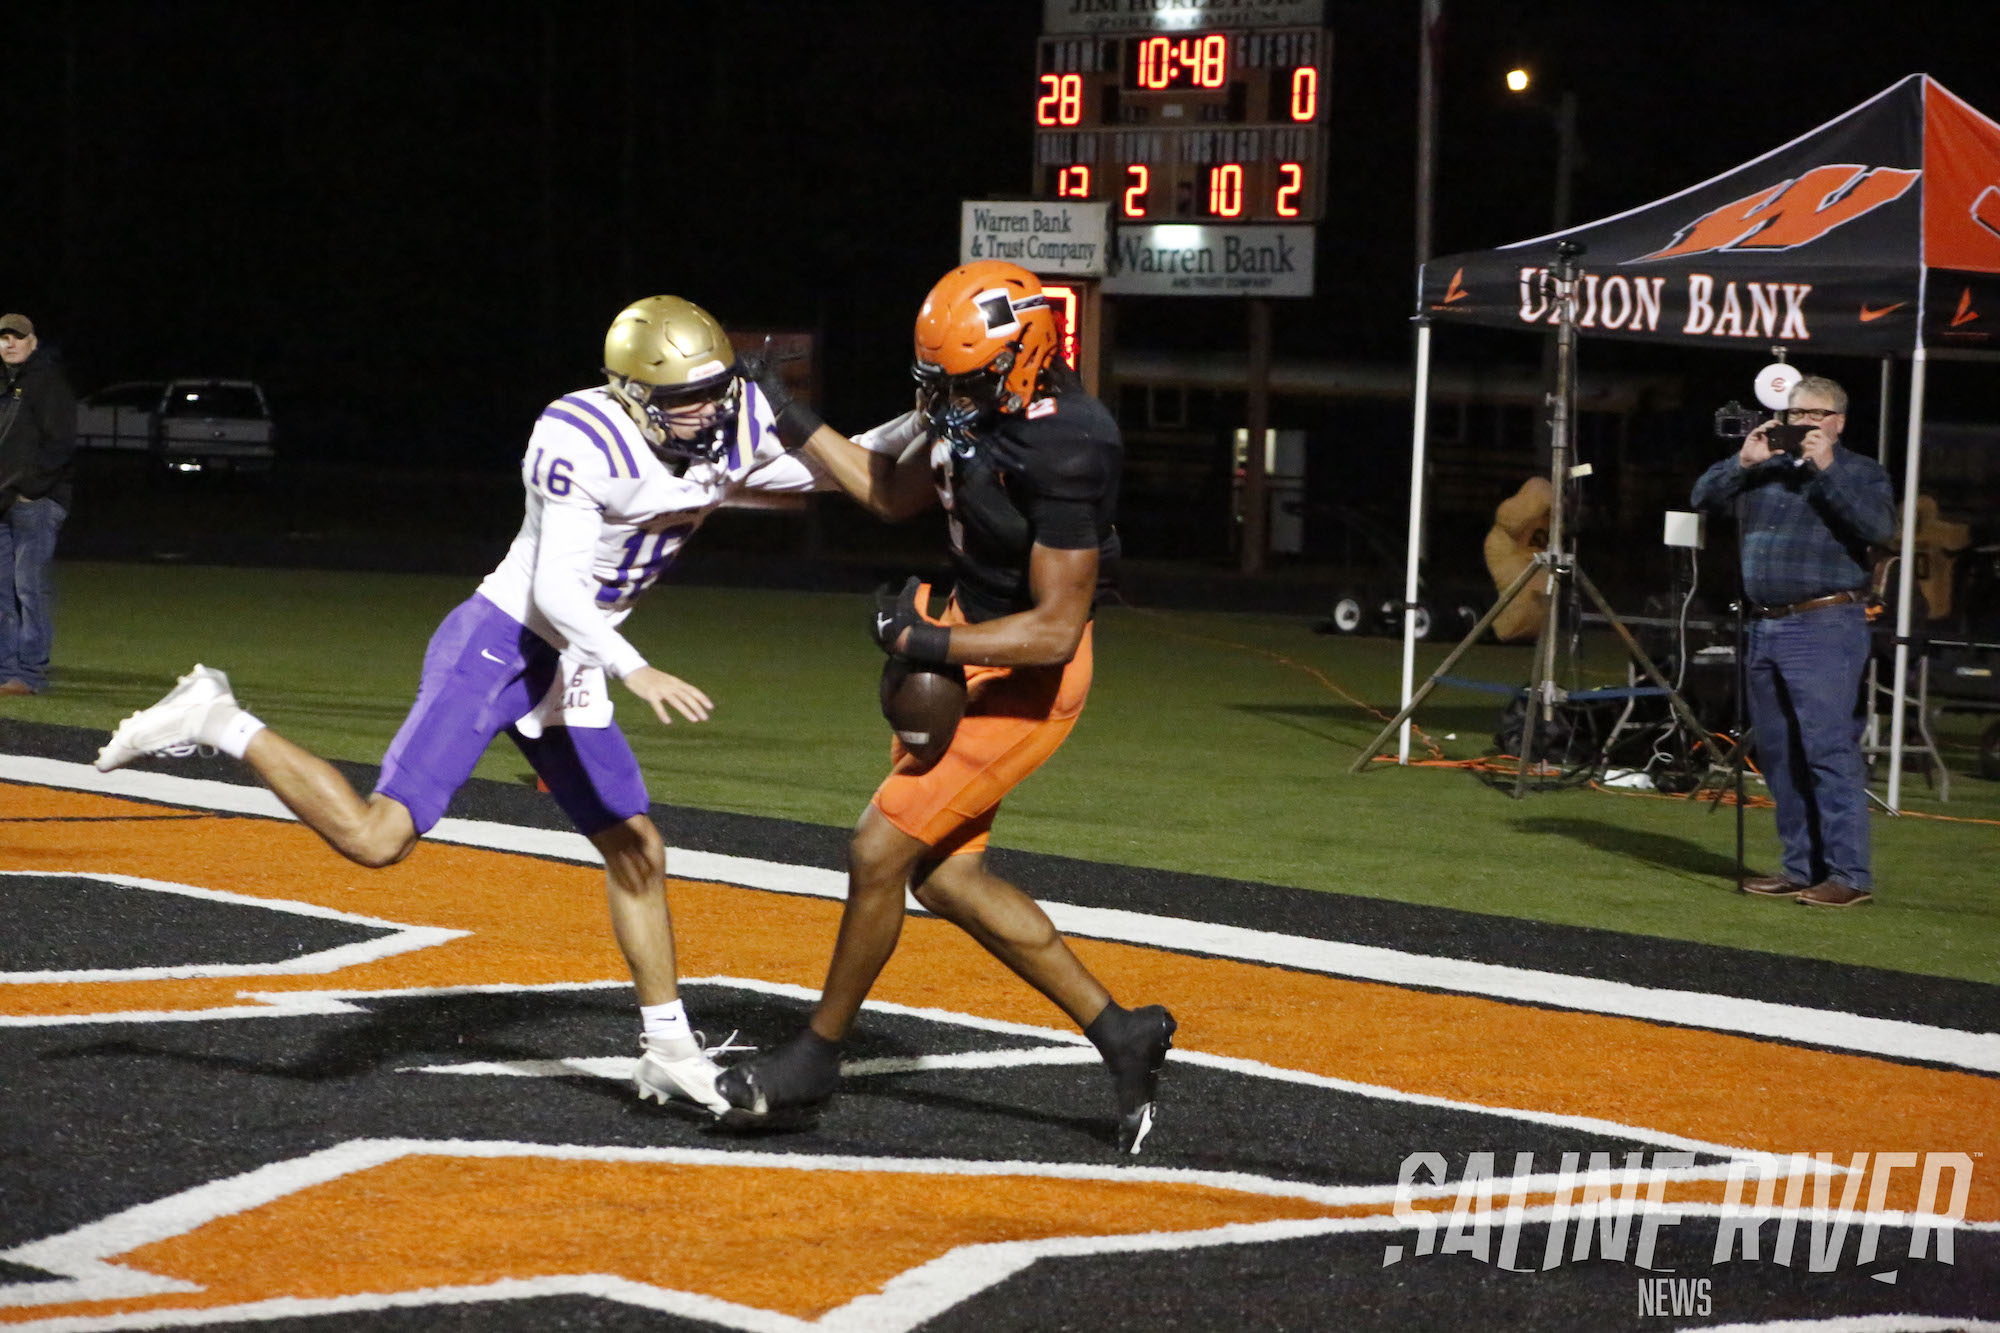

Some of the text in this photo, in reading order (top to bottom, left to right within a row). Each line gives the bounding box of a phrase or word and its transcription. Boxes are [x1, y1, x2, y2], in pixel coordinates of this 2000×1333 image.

[1138, 35, 1226, 89] 10:48
[1037, 74, 1082, 126] 28
[1291, 67, 1317, 121] 0
[1125, 165, 1149, 217] 2
[1210, 164, 1243, 217] 10
[1277, 163, 1302, 217] 2
[974, 208, 1071, 233] Warren Bank
[971, 235, 1096, 268] & Trust Company
[1118, 233, 1296, 275] Warren Bank
[1682, 273, 1813, 339] BANK
[531, 447, 574, 497] 16
